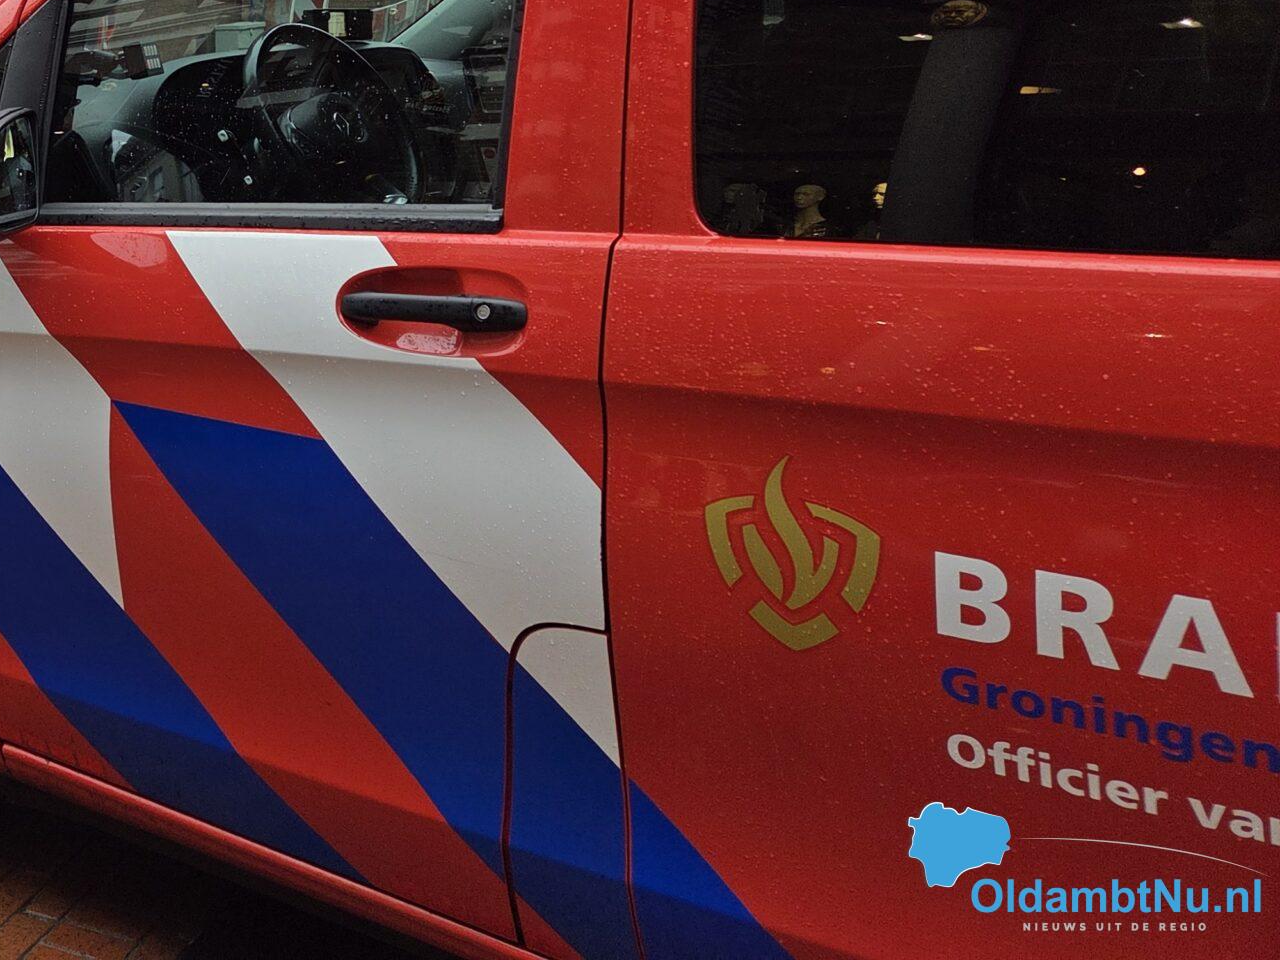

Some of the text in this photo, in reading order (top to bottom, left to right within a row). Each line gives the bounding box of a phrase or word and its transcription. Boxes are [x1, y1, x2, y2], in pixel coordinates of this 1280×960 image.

[934, 551, 1280, 704] BRA
[941, 667, 1280, 775] Groningen
[946, 733, 1168, 816] Officier
